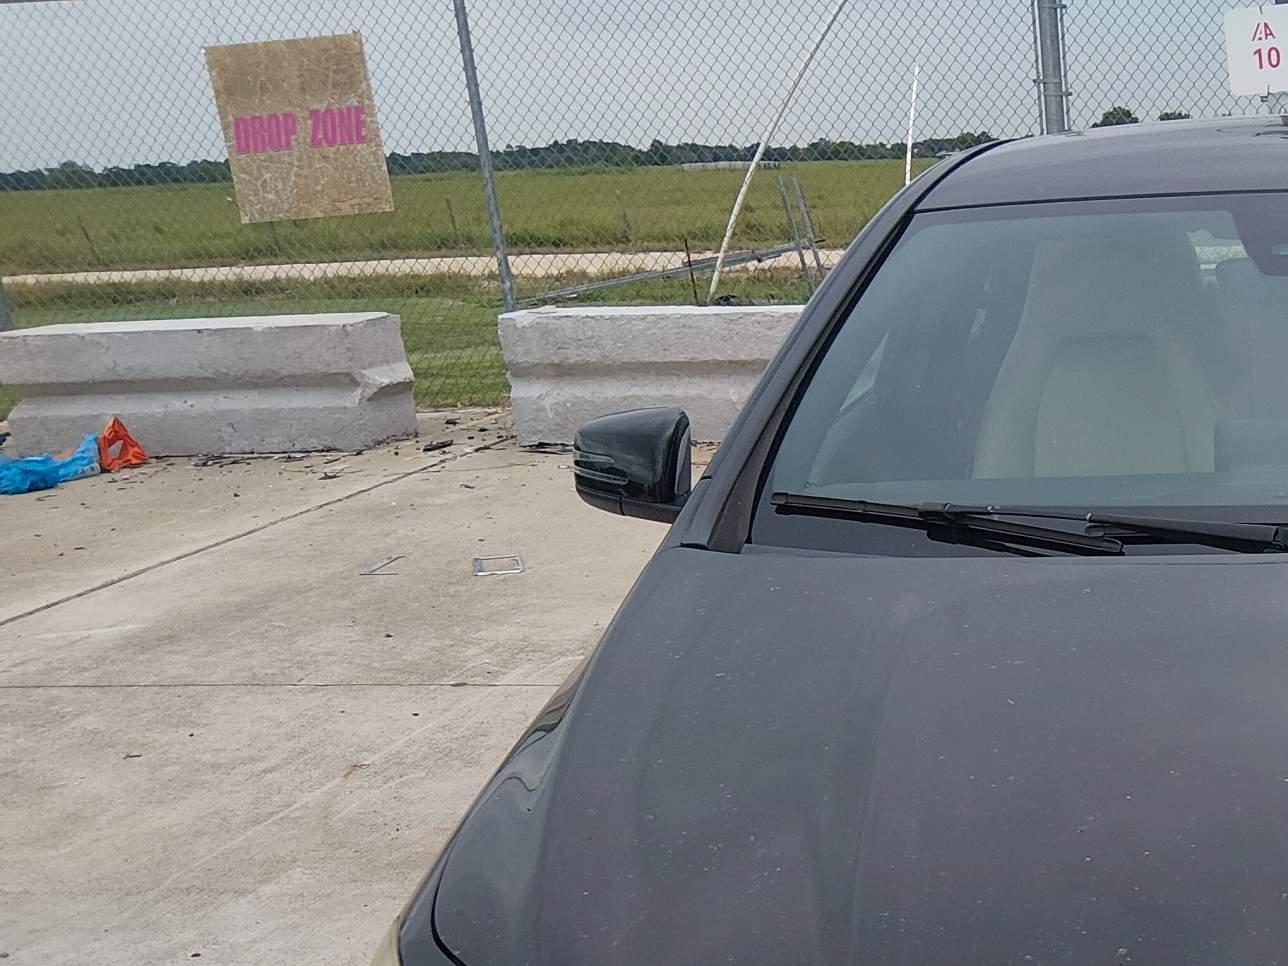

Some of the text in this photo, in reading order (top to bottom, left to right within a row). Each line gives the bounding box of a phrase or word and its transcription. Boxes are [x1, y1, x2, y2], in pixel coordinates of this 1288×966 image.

[1253, 46, 1281, 69] 10
[233, 105, 368, 155] DROP ZONE
